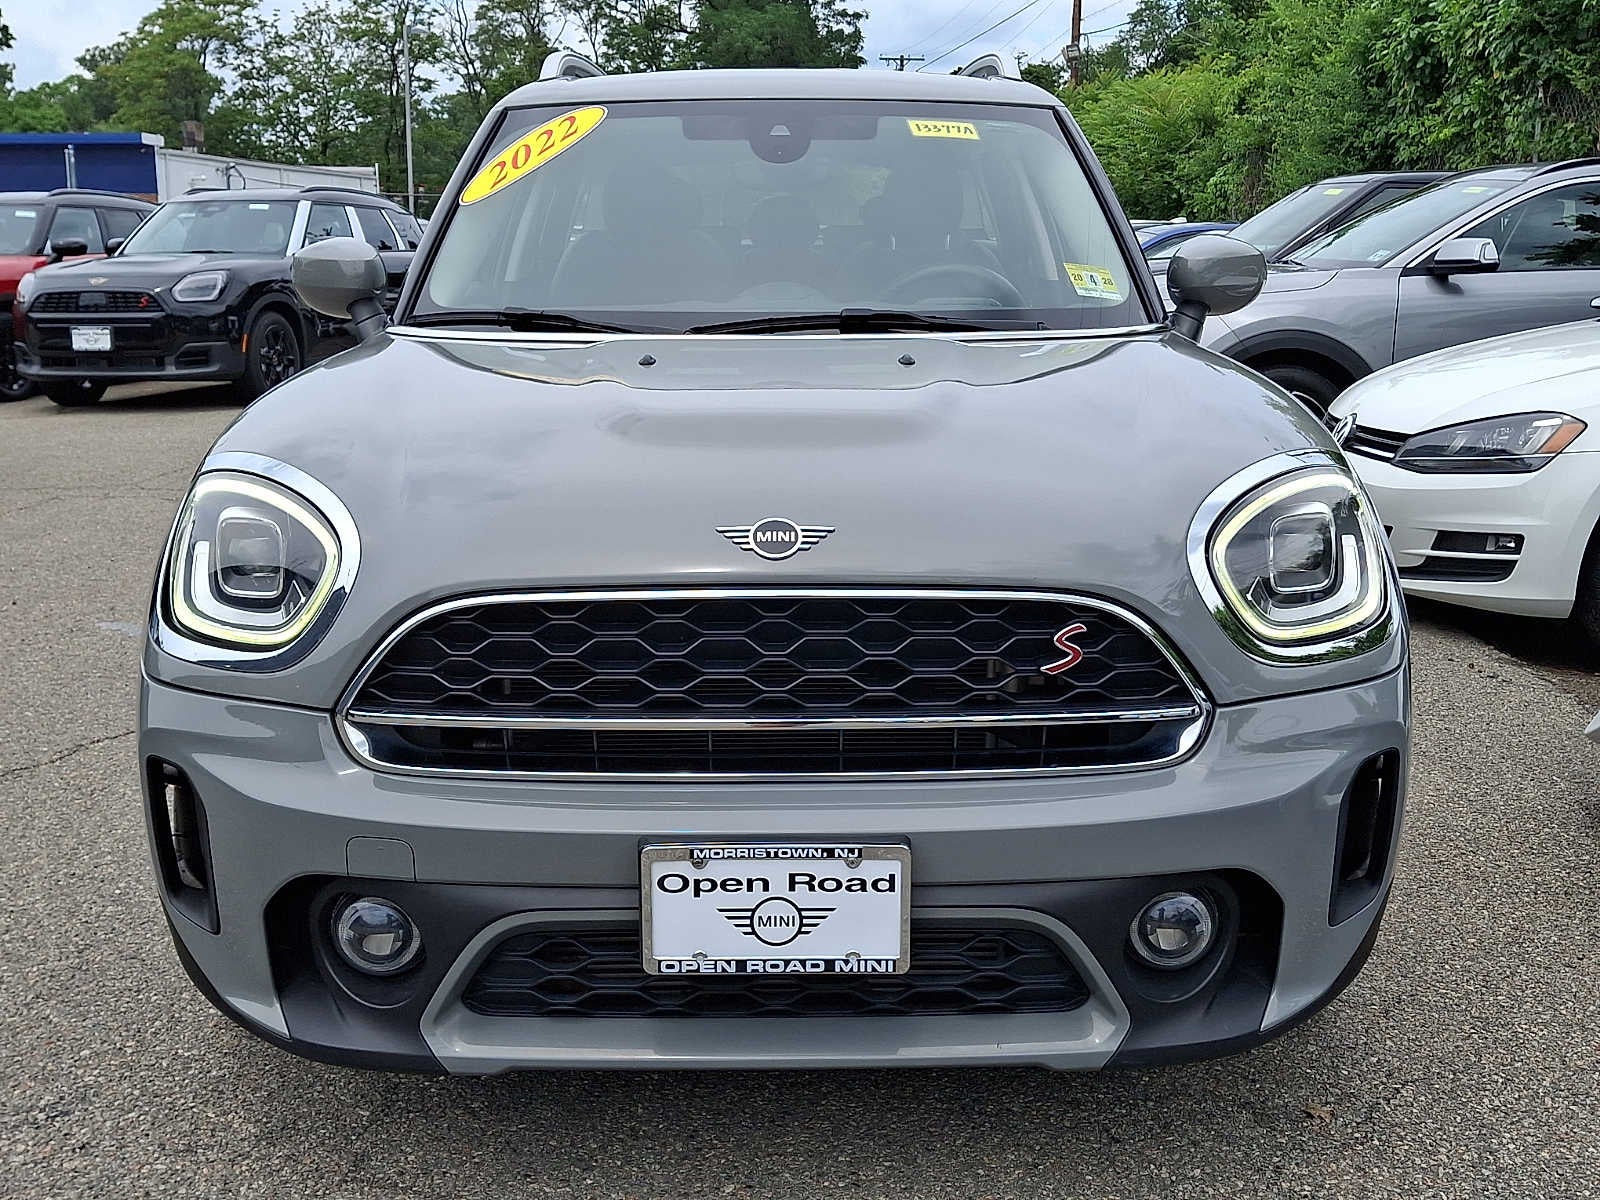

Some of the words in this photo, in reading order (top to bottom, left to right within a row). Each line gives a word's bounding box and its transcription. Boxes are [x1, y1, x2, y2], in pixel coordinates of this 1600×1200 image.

[489, 115, 579, 190] 2022
[1071, 273, 1084, 282] 20
[1089, 274, 1098, 286] 4
[756, 531, 796, 542] MINI
[1040, 623, 1087, 675] S
[693, 849, 828, 859] MORRISTOWN,
[834, 849, 859, 859] NJ
[656, 873, 770, 898] Open
[788, 872, 896, 893] Road
[757, 915, 796, 928] MINI
[660, 960, 736, 973] OPEN
[746, 960, 825, 973] ROAD
[834, 960, 894, 973] MINI
